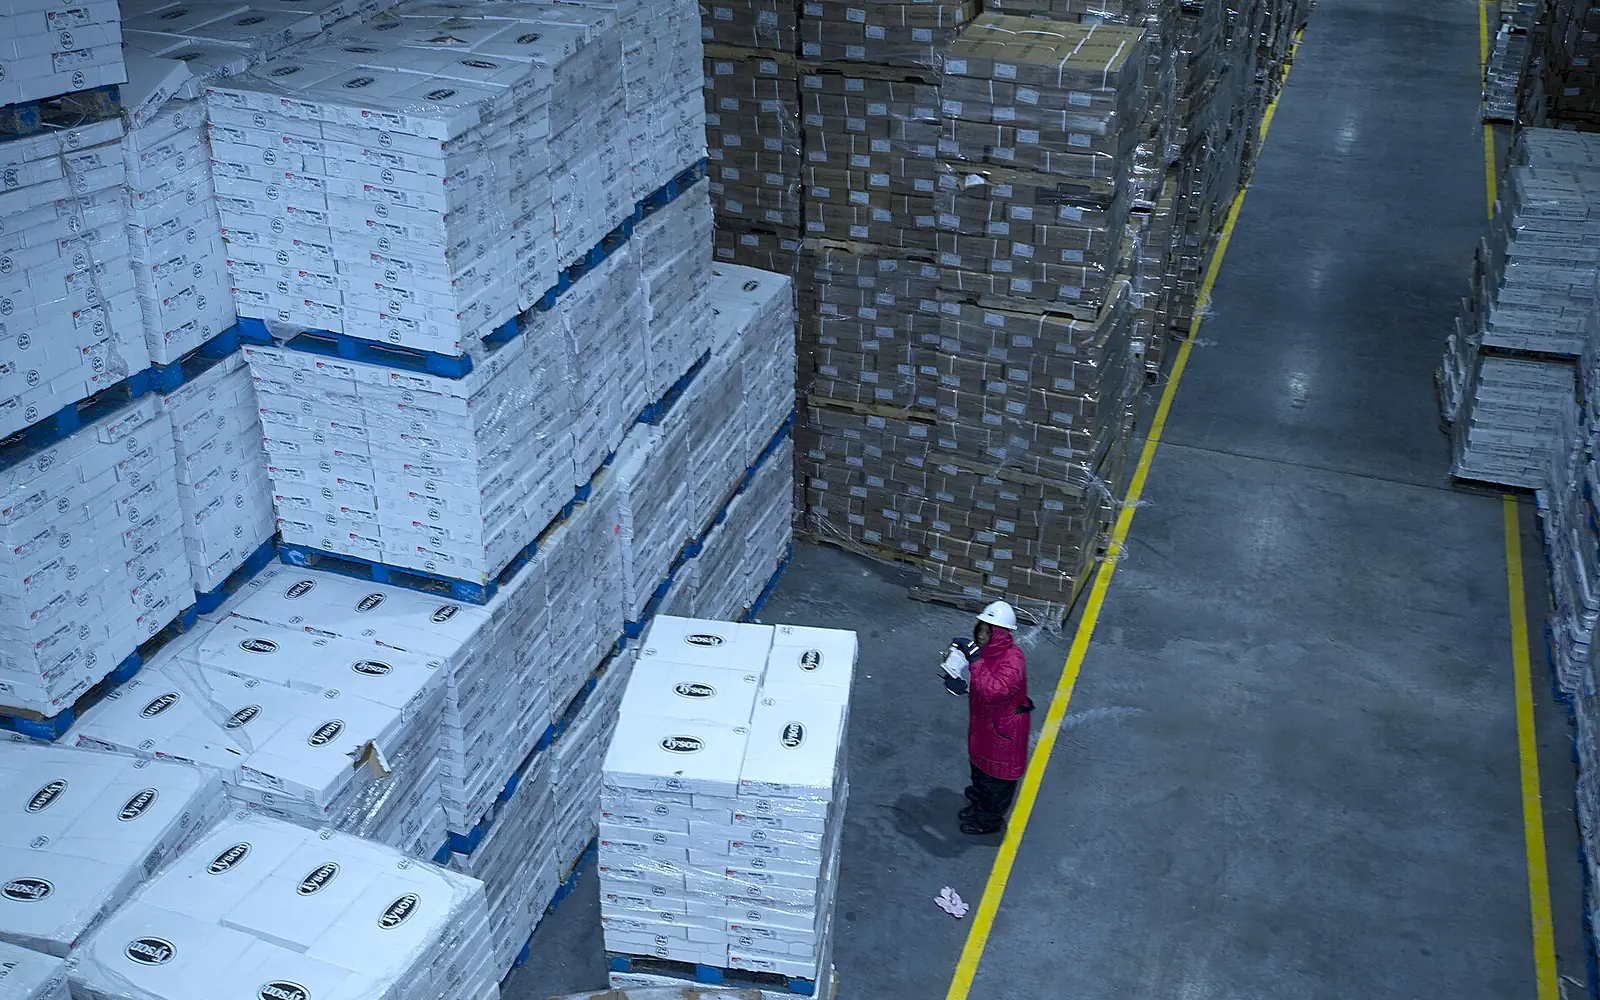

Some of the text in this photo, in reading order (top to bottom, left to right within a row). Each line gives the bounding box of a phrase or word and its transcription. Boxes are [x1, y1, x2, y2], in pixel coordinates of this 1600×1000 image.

[245, 639, 276, 653] Tyson
[358, 661, 390, 675] Tyson
[679, 683, 713, 697] Tyson
[146, 693, 178, 717] Tyson
[313, 720, 342, 744] Tyson
[665, 737, 702, 751] Tyson
[789, 722, 802, 746] Tyson
[31, 781, 64, 812] Tyson
[121, 790, 152, 821] Tyson
[213, 843, 248, 871] Tyson
[304, 864, 336, 891] Tyson
[6, 883, 48, 899] Tyson
[384, 894, 416, 925] Tyson
[130, 942, 170, 963] Tyson
